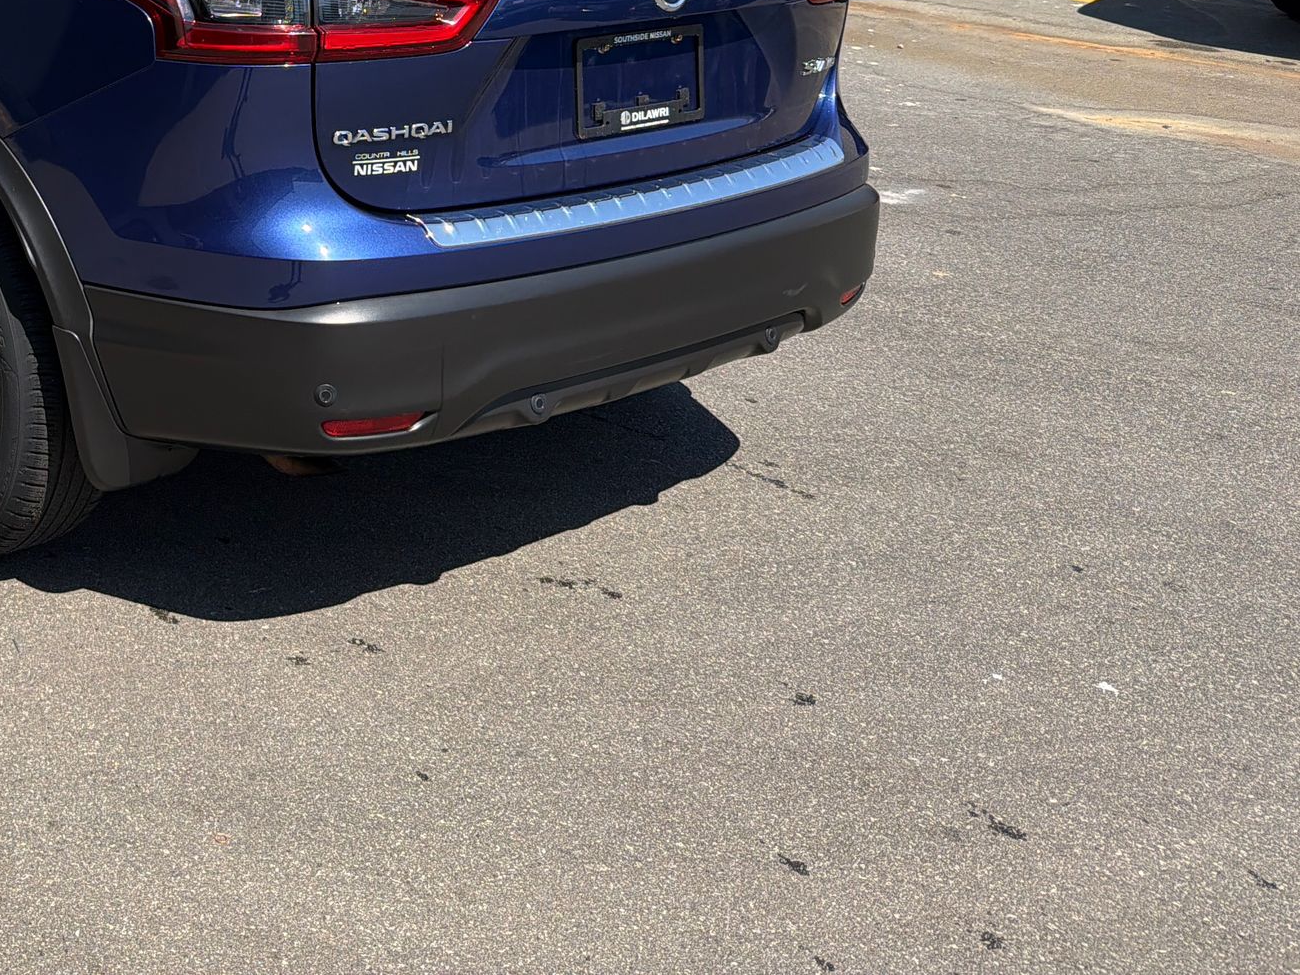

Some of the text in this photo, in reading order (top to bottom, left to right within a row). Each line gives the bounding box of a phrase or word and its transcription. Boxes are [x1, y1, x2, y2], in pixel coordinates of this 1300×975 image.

[614, 30, 672, 44] SOUTHSIDE NISSAN
[631, 106, 669, 122] DILAWRI
[332, 120, 453, 146] QASHQAI
[396, 149, 419, 157] HILLS
[353, 160, 418, 176] NISSAN
